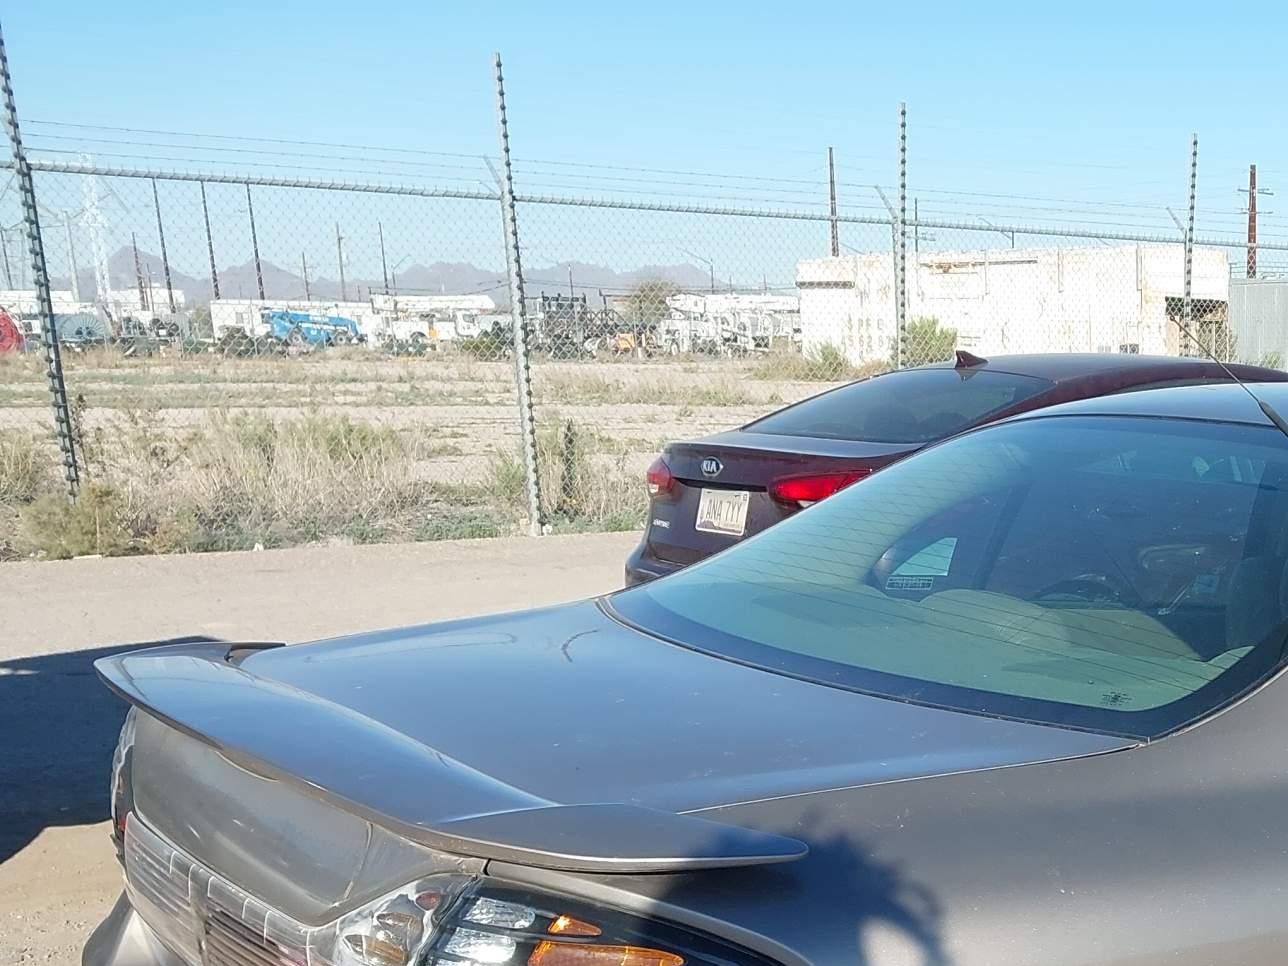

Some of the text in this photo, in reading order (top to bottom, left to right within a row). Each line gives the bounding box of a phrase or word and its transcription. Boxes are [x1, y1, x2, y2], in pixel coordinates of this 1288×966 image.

[703, 460, 717, 472] KIA
[705, 498, 743, 522] ANA 7YY
